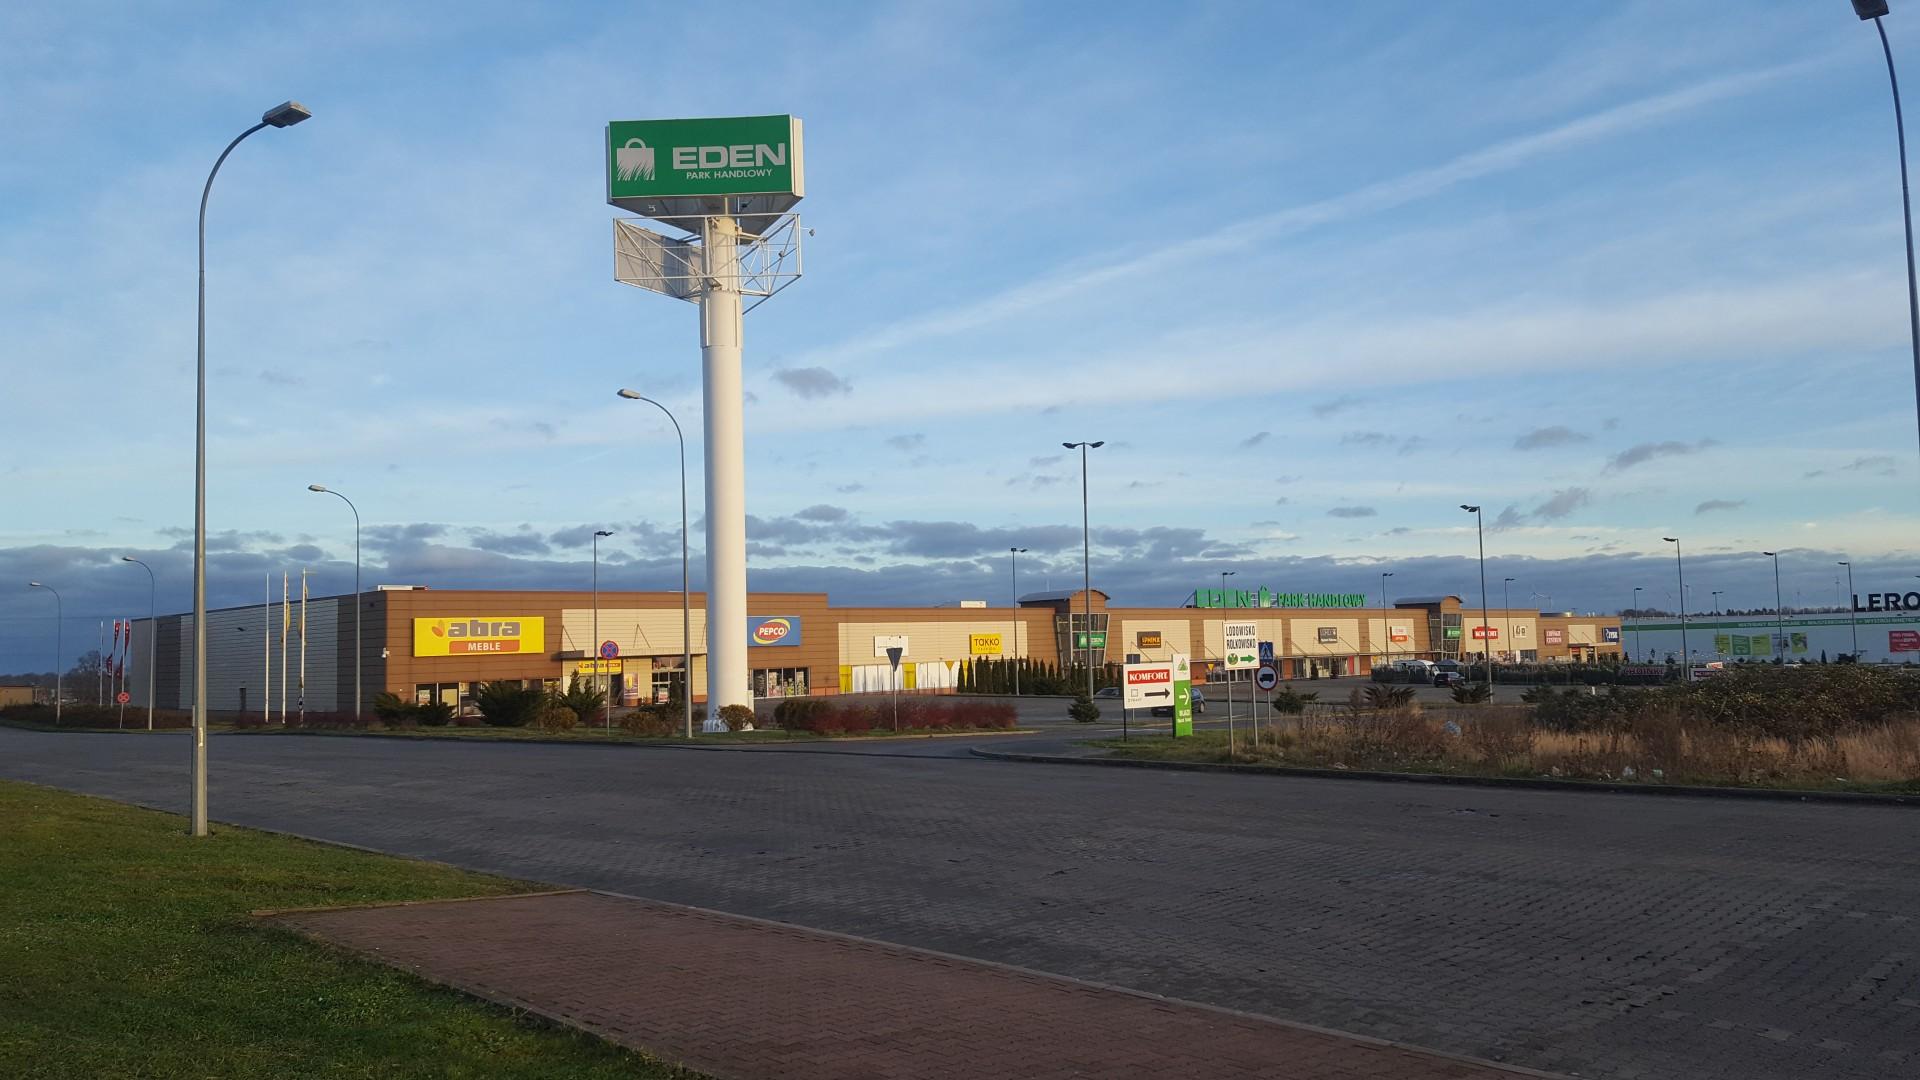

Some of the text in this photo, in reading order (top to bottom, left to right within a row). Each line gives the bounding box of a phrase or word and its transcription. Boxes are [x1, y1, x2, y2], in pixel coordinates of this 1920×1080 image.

[673, 143, 786, 169] EDEN
[686, 168, 773, 180] PARK HANDLOWY
[1277, 593, 1305, 608] PARK
[1308, 593, 1366, 608] HANDLOWY
[1853, 591, 1920, 612] LERO
[448, 619, 521, 638] abra
[759, 627, 785, 636] PEPCO
[1225, 625, 1256, 637] LODOWISKO
[467, 641, 501, 652] MEBLE
[1226, 638, 1257, 650] ROLKOWISKO
[1129, 671, 1168, 682] KOMFORT
